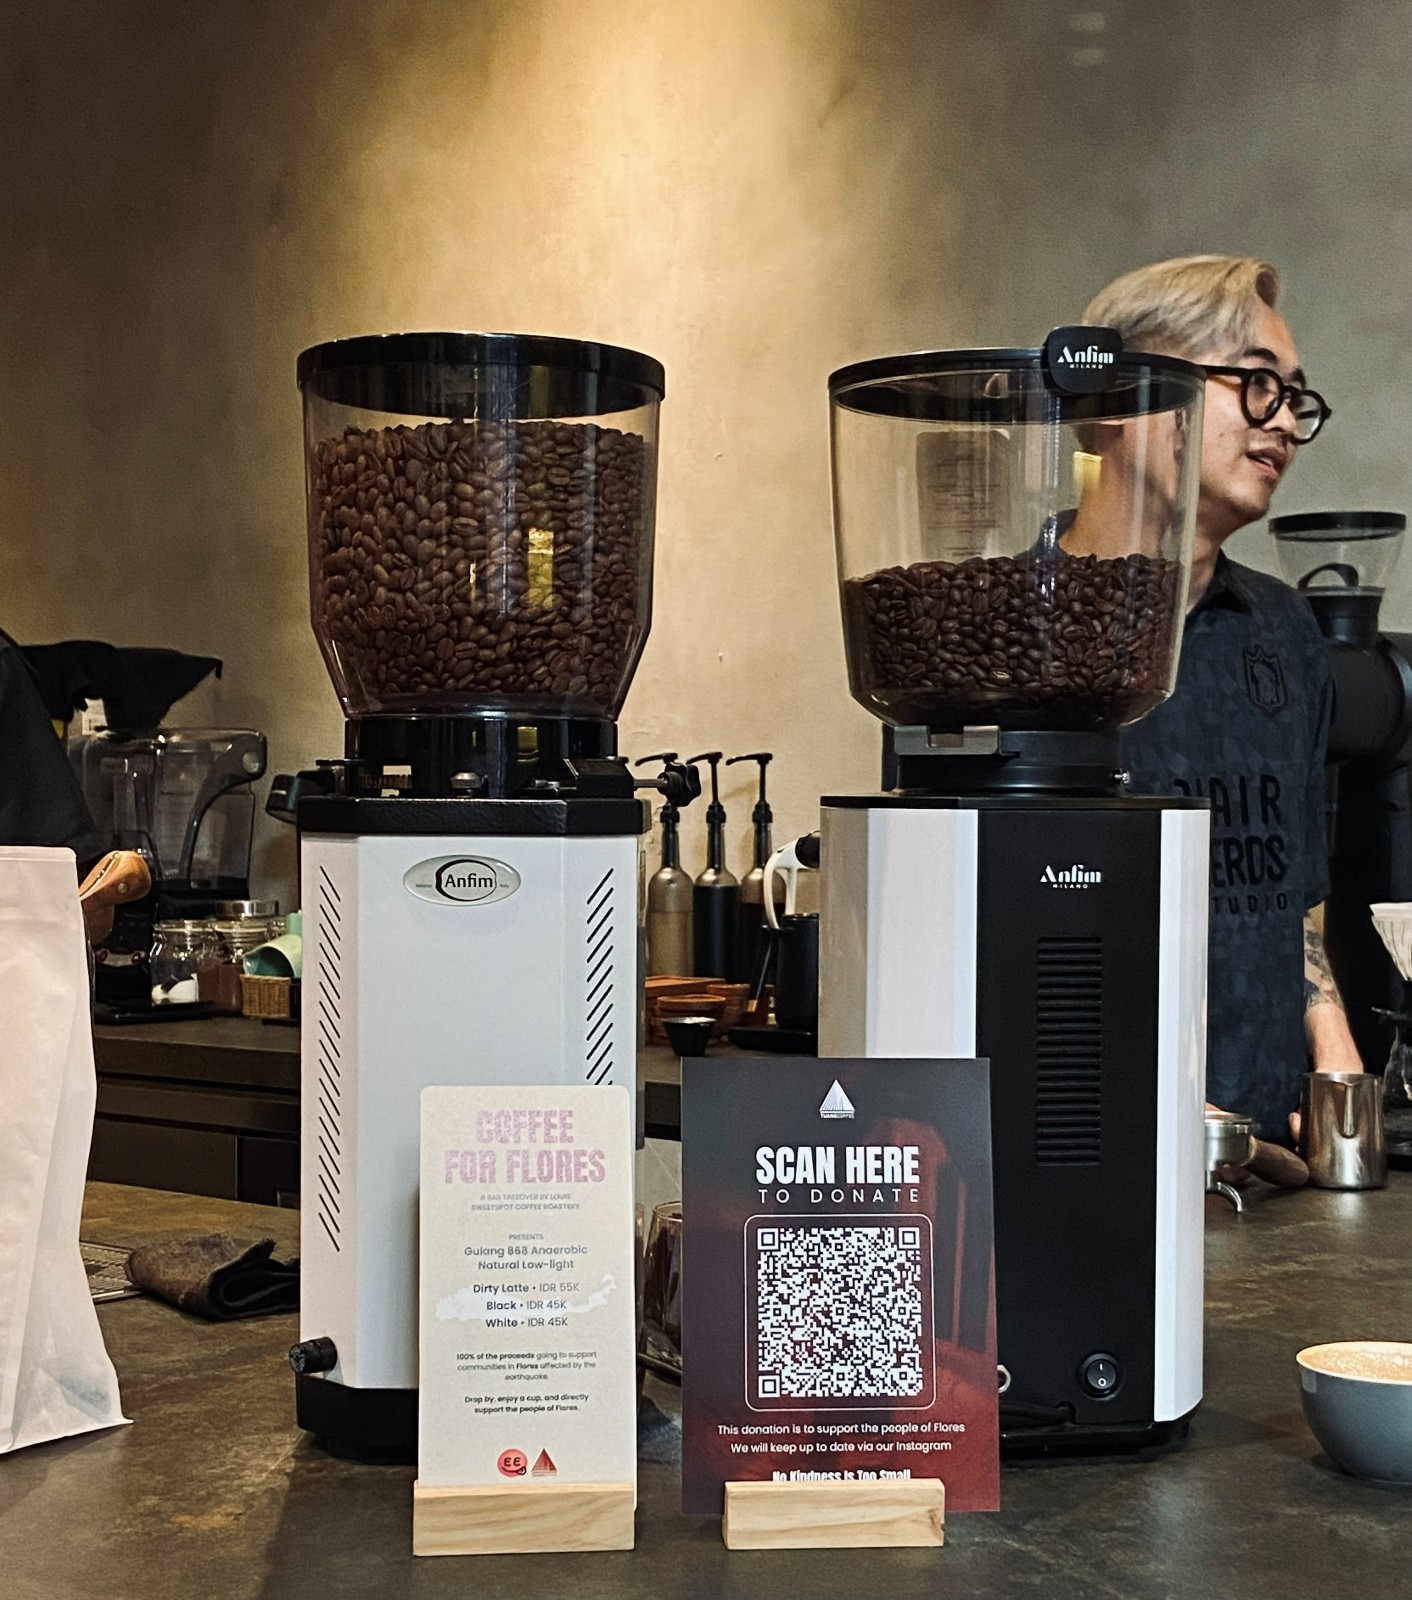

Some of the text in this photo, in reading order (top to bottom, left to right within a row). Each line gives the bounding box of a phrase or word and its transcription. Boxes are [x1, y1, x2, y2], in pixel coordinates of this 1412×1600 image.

[1057, 345, 1114, 364] Anfim
[1210, 834, 1286, 887] ERDS
[445, 873, 493, 888] Anfim
[1040, 864, 1102, 883] Anfim
[1213, 893, 1287, 914] TUDIO
[476, 1110, 575, 1144] COFFEE
[445, 1149, 606, 1184] FOR FLORES
[755, 1146, 920, 1184] SCAN HERE
[758, 1188, 919, 1204] TO DONATE
[508, 1246, 528, 1255] 868
[531, 1245, 588, 1255] Anaerobic
[478, 1259, 574, 1271] Natural Low-light
[473, 1283, 580, 1295] Dirty Latte IDR 55K
[486, 1300, 567, 1310] Black IDR 45K
[485, 1317, 568, 1328] White IDR 45K
[500, 1352, 534, 1361] proceeds
[536, 1352, 557, 1361] going
[569, 1351, 597, 1360] support
[573, 1362, 582, 1370] by
[464, 1396, 482, 1404] Drop
[498, 1395, 518, 1403] enjoy
[561, 1394, 589, 1402] directly
[474, 1406, 504, 1414] support
[520, 1405, 546, 1414] people
[718, 1422, 966, 1436] This donation is to support the people of Flores
[730, 1441, 952, 1455] We will keep up to date via our Instagram
